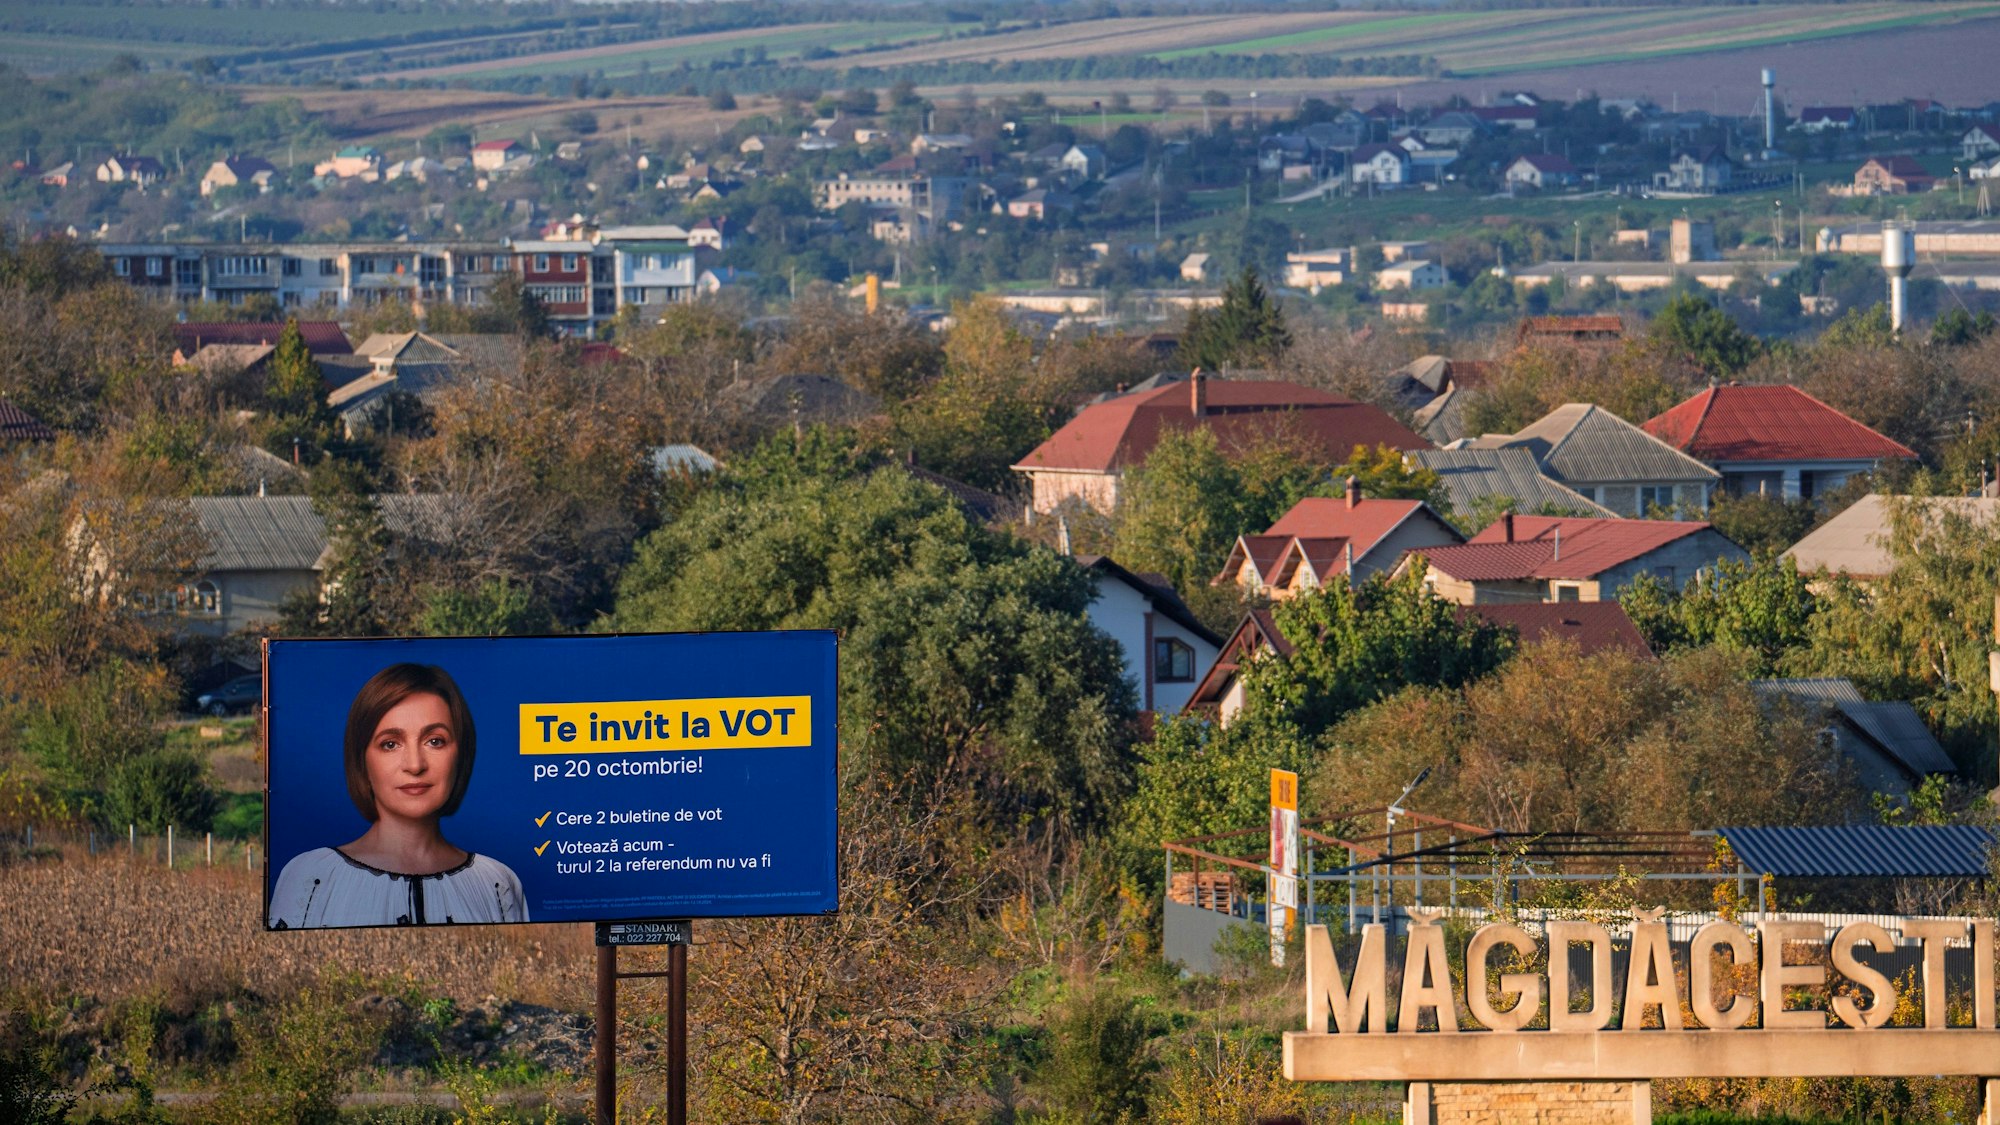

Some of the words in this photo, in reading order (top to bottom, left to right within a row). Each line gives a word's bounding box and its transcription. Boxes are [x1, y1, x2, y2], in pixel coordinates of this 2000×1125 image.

[536, 715, 577, 743] Te
[590, 710, 669, 741] invit
[681, 711, 710, 738] la
[719, 708, 796, 737] VOT
[533, 763, 559, 782] pe
[564, 760, 590, 778] 20
[597, 756, 703, 777] octombrie!
[556, 811, 592, 825] Cere
[596, 811, 606, 825] 2
[610, 809, 670, 824] buletine
[674, 808, 693, 822] de
[697, 808, 723, 821] vot
[556, 839, 618, 855] Votează
[623, 840, 663, 852] acum
[556, 860, 592, 874] turul
[595, 859, 605, 873] 2
[609, 859, 622, 872] la
[626, 856, 713, 871] referendum
[716, 857, 735, 869] nu
[739, 857, 757, 868] va
[761, 853, 771, 868] fi
[625, 923, 680, 933] STANDART
[608, 934, 625, 943] tel.:
[627, 934, 643, 943] 022
[645, 934, 662, 942] 227
[665, 933, 680, 942] 704
[1306, 905, 1997, 1030] MĂGDĂCEȘTI
